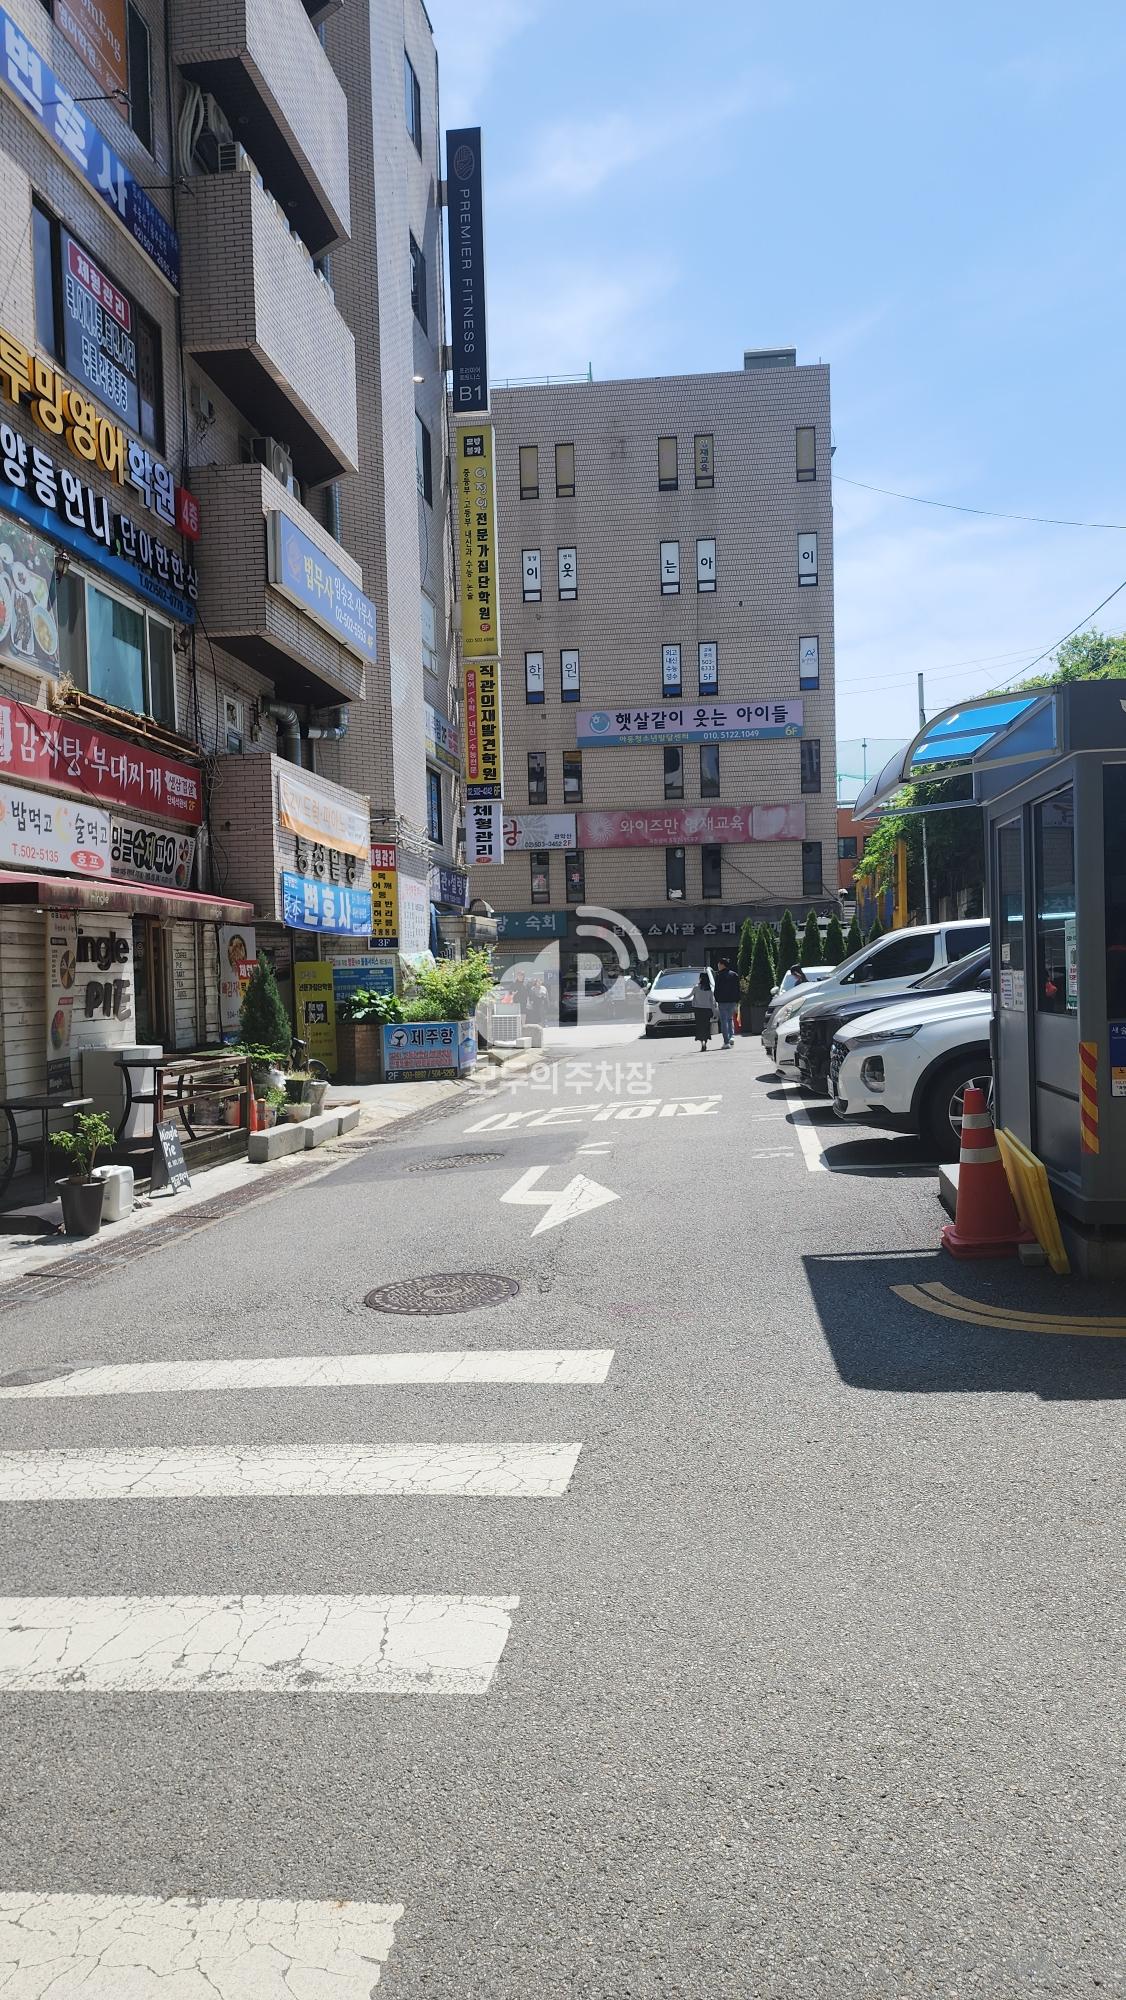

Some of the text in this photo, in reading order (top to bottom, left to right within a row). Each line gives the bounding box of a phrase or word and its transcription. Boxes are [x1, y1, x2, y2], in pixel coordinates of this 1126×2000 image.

[5, 18, 127, 218] 변호사
[460, 188, 472, 270] PREMIER
[77, 255, 125, 321] 체형관리
[461, 278, 474, 352] FITNESS
[459, 385, 482, 402] B1
[182, 499, 199, 532] 4층
[476, 512, 491, 620] 전문가집단학원
[527, 550, 814, 580] 이 웃 는 아 이
[304, 555, 335, 609] 법무사
[355, 599, 374, 629] 사무소
[529, 662, 577, 680] 학 원
[703, 673, 713, 681] 5F
[480, 665, 497, 781] 직관의재발견학원
[615, 705, 788, 731] 햇살같이 웃는 아이들
[785, 725, 797, 737] 6F
[11, 800, 108, 846] 밥먹고 술먹고
[473, 804, 493, 856] 체형관리
[620, 818, 679, 835] 와이즈만
[12, 843, 59, 863] T.502-5135
[563, 839, 572, 847] 2F
[77, 852, 100, 869] 호프
[303, 883, 351, 929] 변호사
[377, 938, 391, 947] 3F
[647, 922, 696, 936] 소사골
[702, 921, 736, 935] 순대
[85, 979, 131, 1022] PIE
[411, 1027, 454, 1046] 제주항
[388, 1071, 399, 1081] 2F
[464, 1095, 723, 1133] 진입금지
[163, 1141, 177, 1158] Pie
